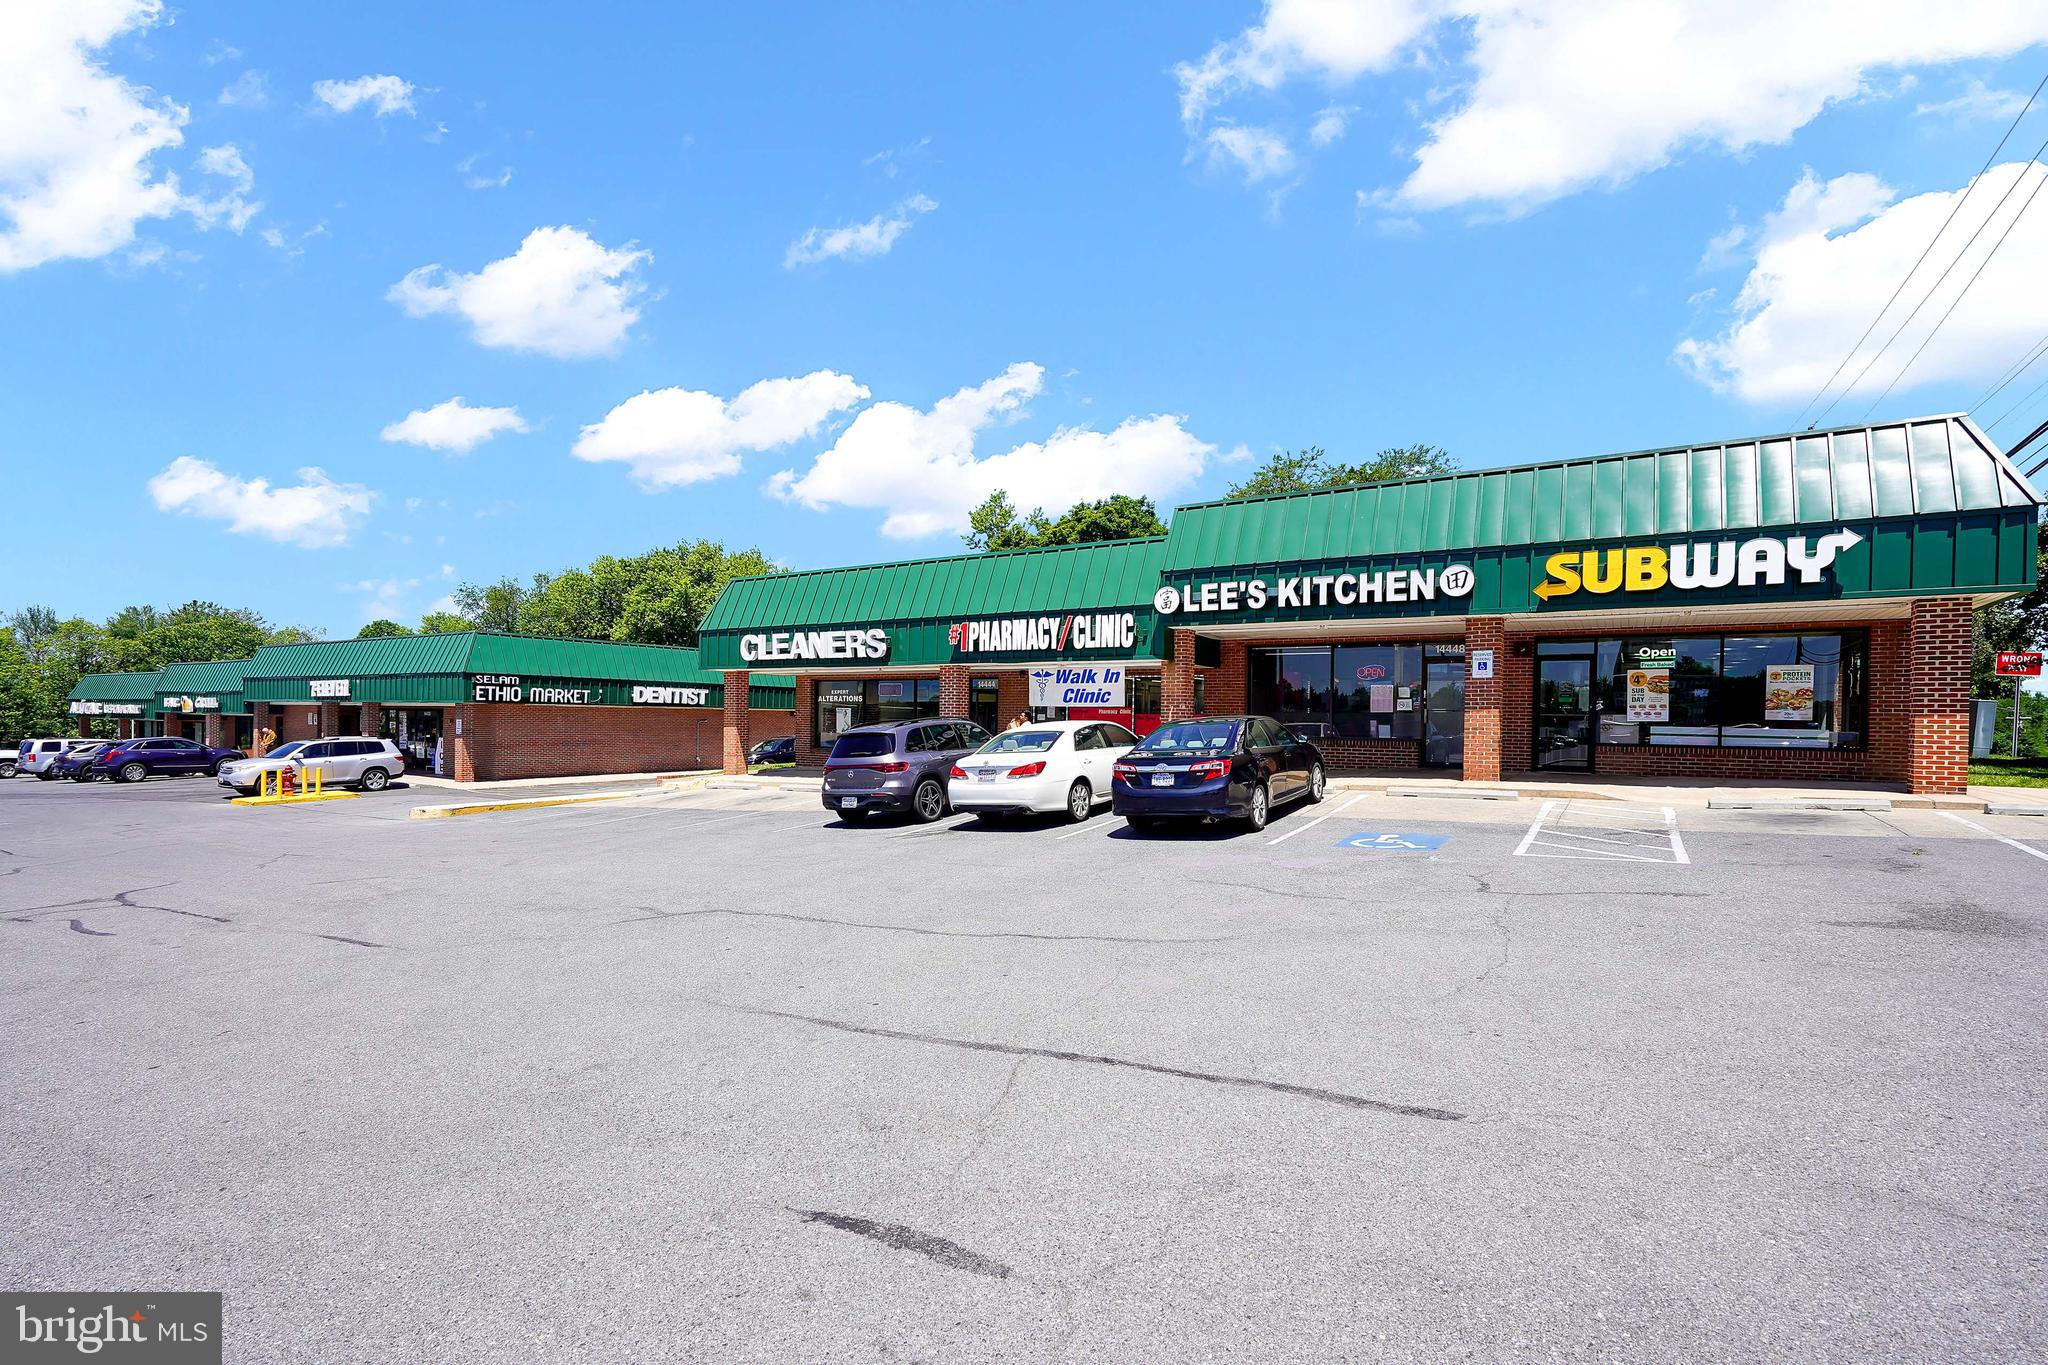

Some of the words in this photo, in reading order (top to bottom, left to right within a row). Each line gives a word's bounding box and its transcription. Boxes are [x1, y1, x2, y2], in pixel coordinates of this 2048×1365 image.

[1534, 528, 1862, 600] SUBWAY
[1183, 579, 1268, 613] LEE'S
[1277, 568, 1435, 608] KITCHEN
[740, 628, 888, 661] CLEANERS
[1435, 644, 1466, 653] 14448
[1639, 647, 1676, 659] Open
[2001, 655, 2038, 663] WRONG
[1055, 669, 1098, 684] Walk
[1102, 668, 1121, 683] In
[1357, 667, 1385, 677] OPEN
[475, 675, 519, 685] SELAM
[475, 686, 521, 701] ETHIO
[530, 687, 591, 704] MARKET
[632, 685, 709, 705] DENTIST
[1062, 688, 1112, 703] Clinic
